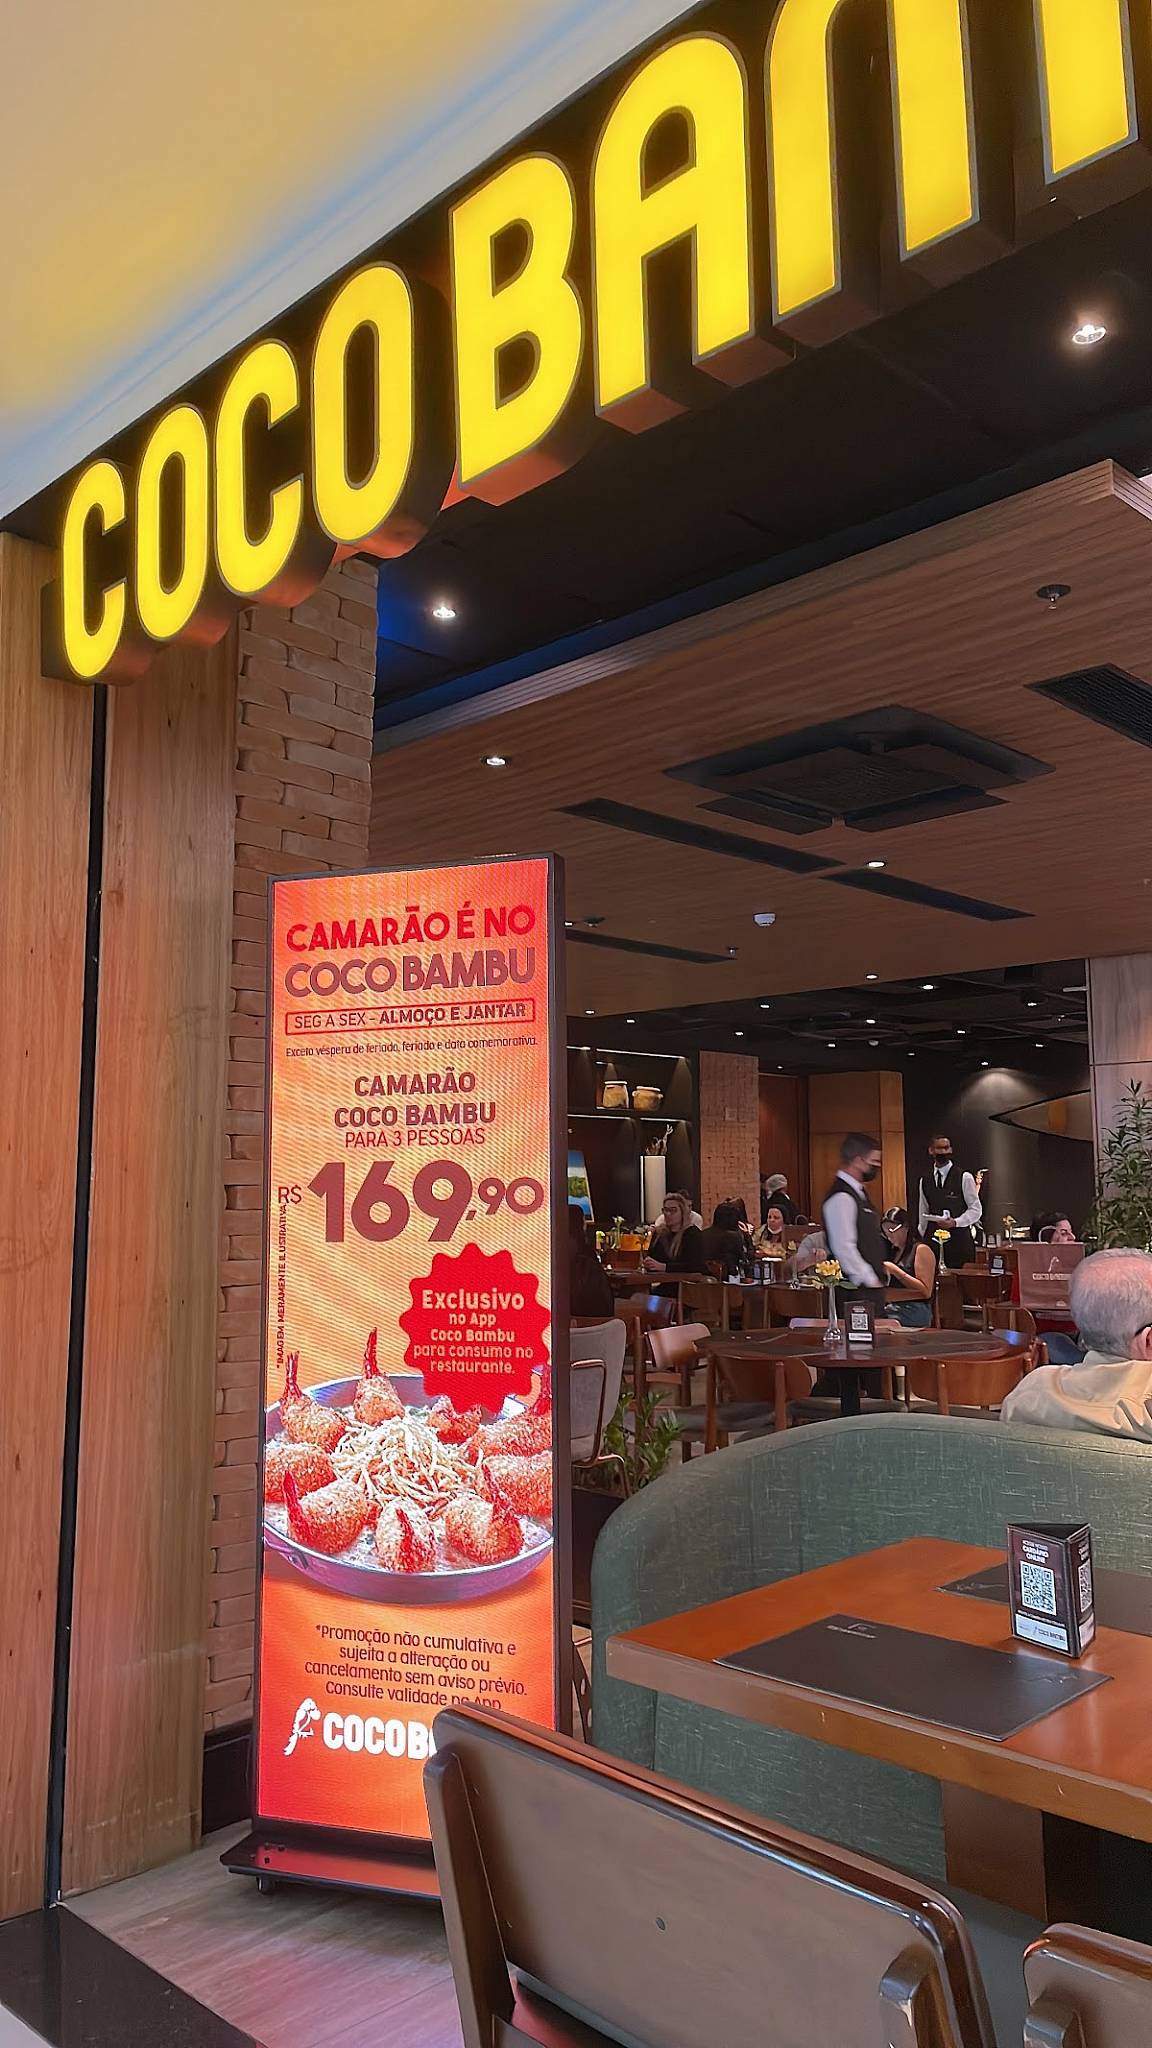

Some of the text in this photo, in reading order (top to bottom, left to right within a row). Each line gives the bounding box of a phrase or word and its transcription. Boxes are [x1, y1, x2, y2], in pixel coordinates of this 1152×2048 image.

[61, 261, 415, 681] COCO
[286, 901, 536, 952] CAMARÃO É NO
[285, 947, 536, 998] COCO BAMBU
[294, 1014, 322, 1029] SEG
[325, 1014, 335, 1028] A
[339, 1012, 366, 1027] SEX
[379, 1008, 446, 1026] ALMOÇO
[450, 1006, 460, 1021] E
[464, 1002, 526, 1020] JANTAR
[286, 1047, 313, 1057] Exceto
[316, 1044, 351, 1058] véspera
[353, 1043, 364, 1054] de
[402, 1040, 435, 1052] feriado
[437, 1041, 442, 1050] e
[445, 1038, 466, 1050] data
[468, 1034, 538, 1048] comemorativa.
[354, 1066, 476, 1097] CAMARÃO
[334, 1101, 496, 1128] COCO BAMBU
[345, 1127, 486, 1148] PARA 3 PESSOAS
[278, 1160, 545, 1242] R$ 169,90
[278, 1263, 286, 1322] MERAMENTE
[422, 1287, 525, 1310] Exclusivo
[449, 1312, 497, 1328] no App
[430, 1328, 515, 1342] Coco Bambu
[413, 1344, 534, 1359] para consumo no
[430, 1360, 515, 1374] restaurante.
[394, 1631, 420, 1647] não
[424, 1635, 504, 1655] cumulativa
[507, 1642, 516, 1656] e
[340, 1645, 490, 1673] sujeita a alteração ou
[305, 1661, 527, 1696] cancelamento sem aviso prévio.
[326, 1680, 384, 1700] Consulte
[387, 1687, 447, 1706] validade
